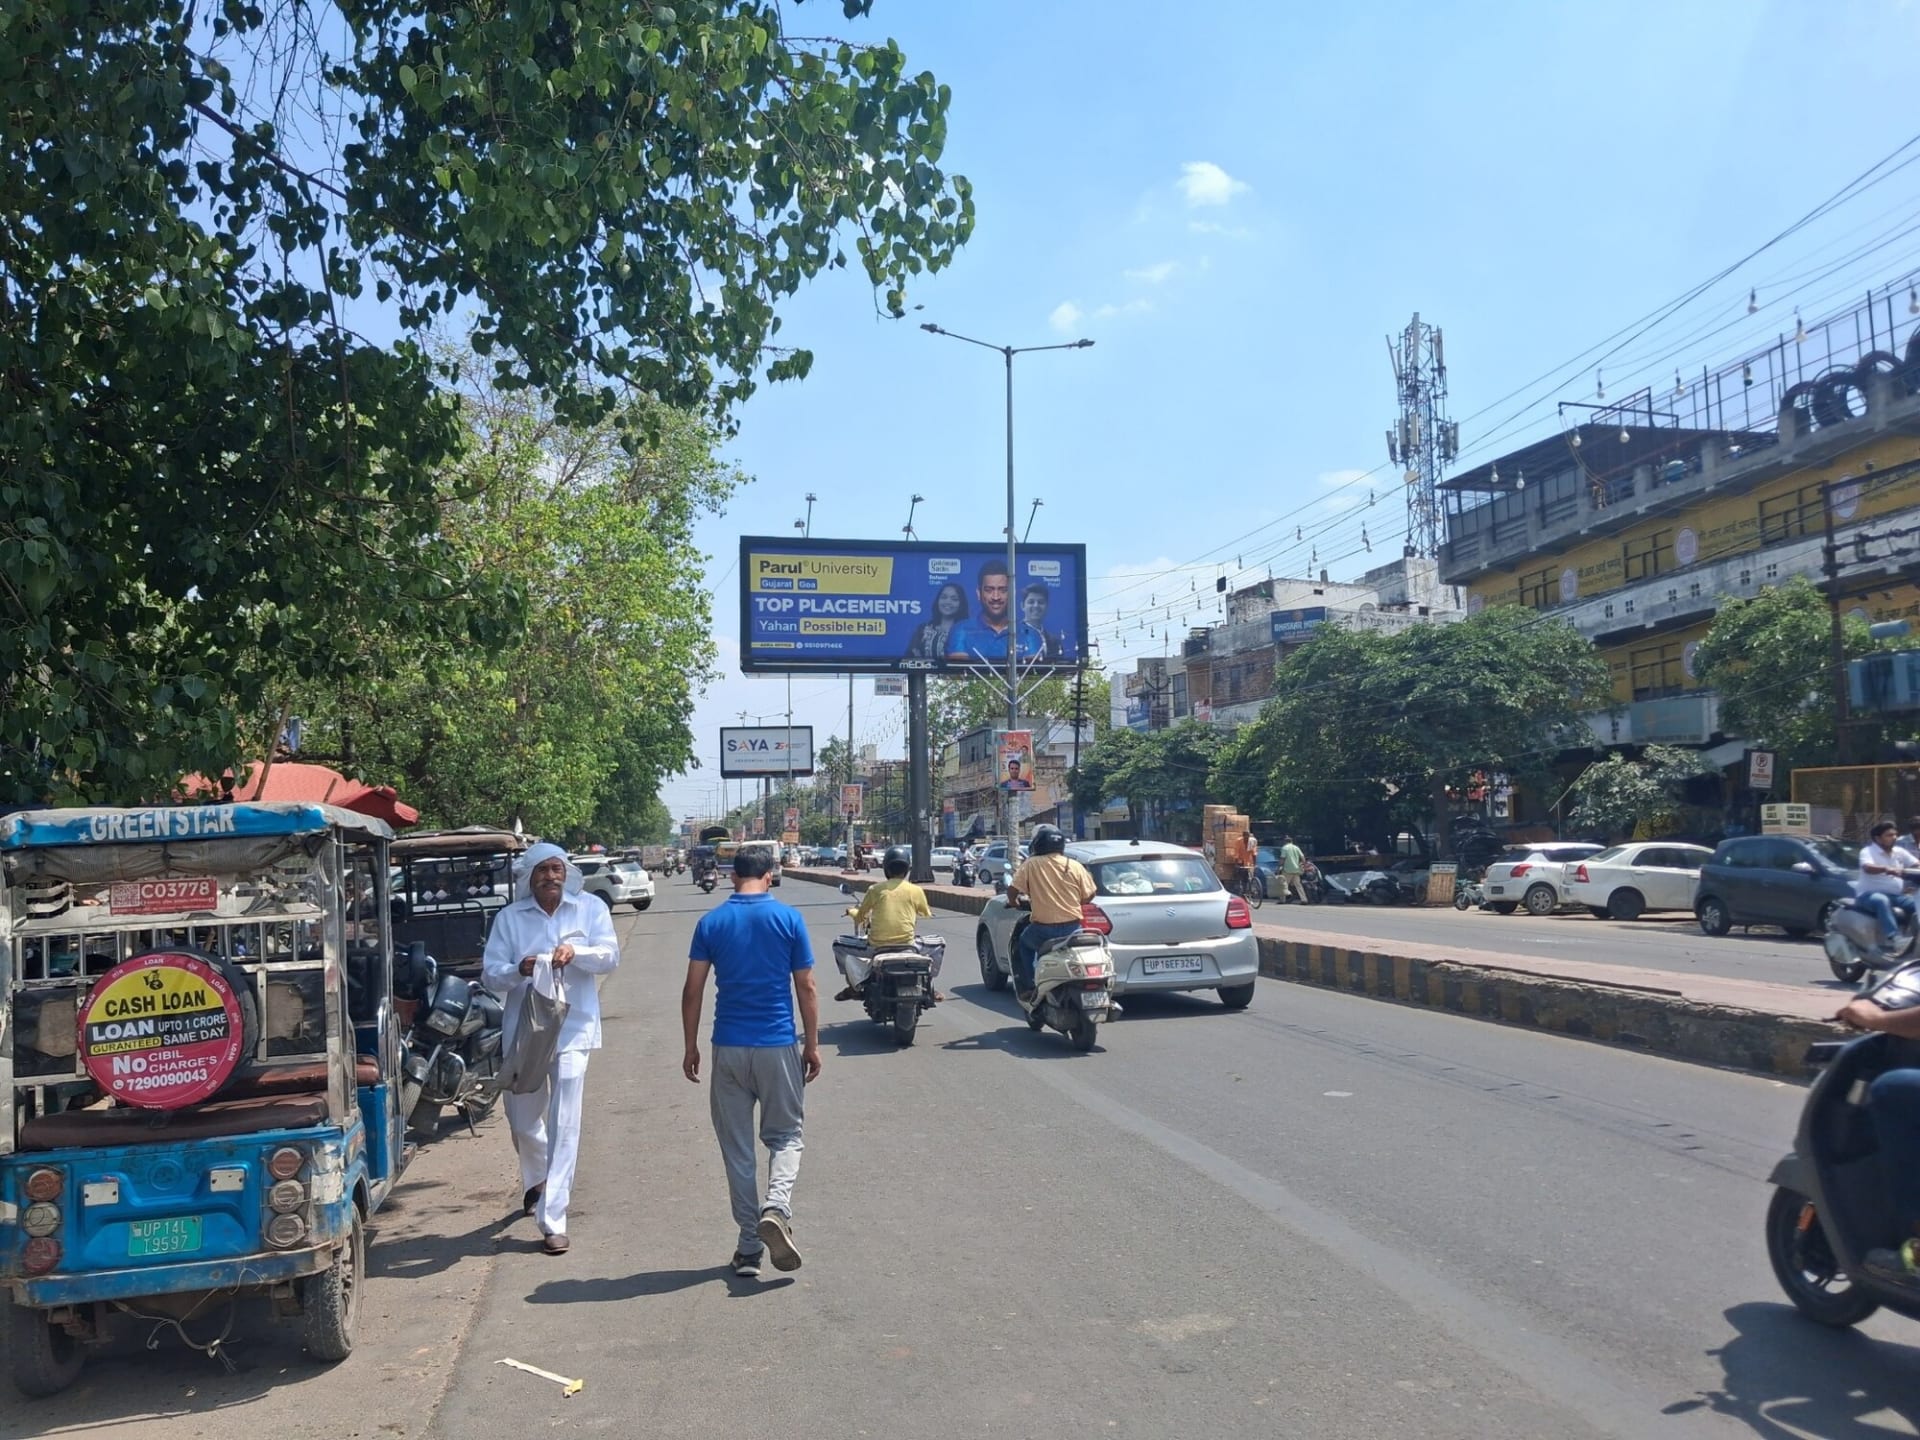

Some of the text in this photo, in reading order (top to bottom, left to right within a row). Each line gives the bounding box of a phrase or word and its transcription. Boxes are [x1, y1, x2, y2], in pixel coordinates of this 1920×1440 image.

[759, 560, 878, 577] Parul University
[761, 579, 816, 589] Gujarat Goa
[755, 598, 921, 614] TOP PLACEMENTS
[759, 620, 882, 632] Yahan Possible Hai!
[727, 739, 769, 752] SAYA
[90, 806, 235, 841] GREEN STAR
[141, 882, 210, 898] C03778
[211, 979, 226, 993] LOAN
[105, 990, 206, 1017] CASH LOAN
[92, 1019, 154, 1042] LOAN
[158, 1020, 183, 1032] UPTO
[185, 1019, 191, 1029] 1
[193, 1013, 228, 1029] CRORE
[92, 1026, 226, 1054] GURANTEED SAME DAY
[149, 1050, 184, 1062] CIBIL
[149, 1055, 218, 1073] CHARGE'S
[113, 1055, 147, 1076] No
[127, 1068, 208, 1091] 7290090043
